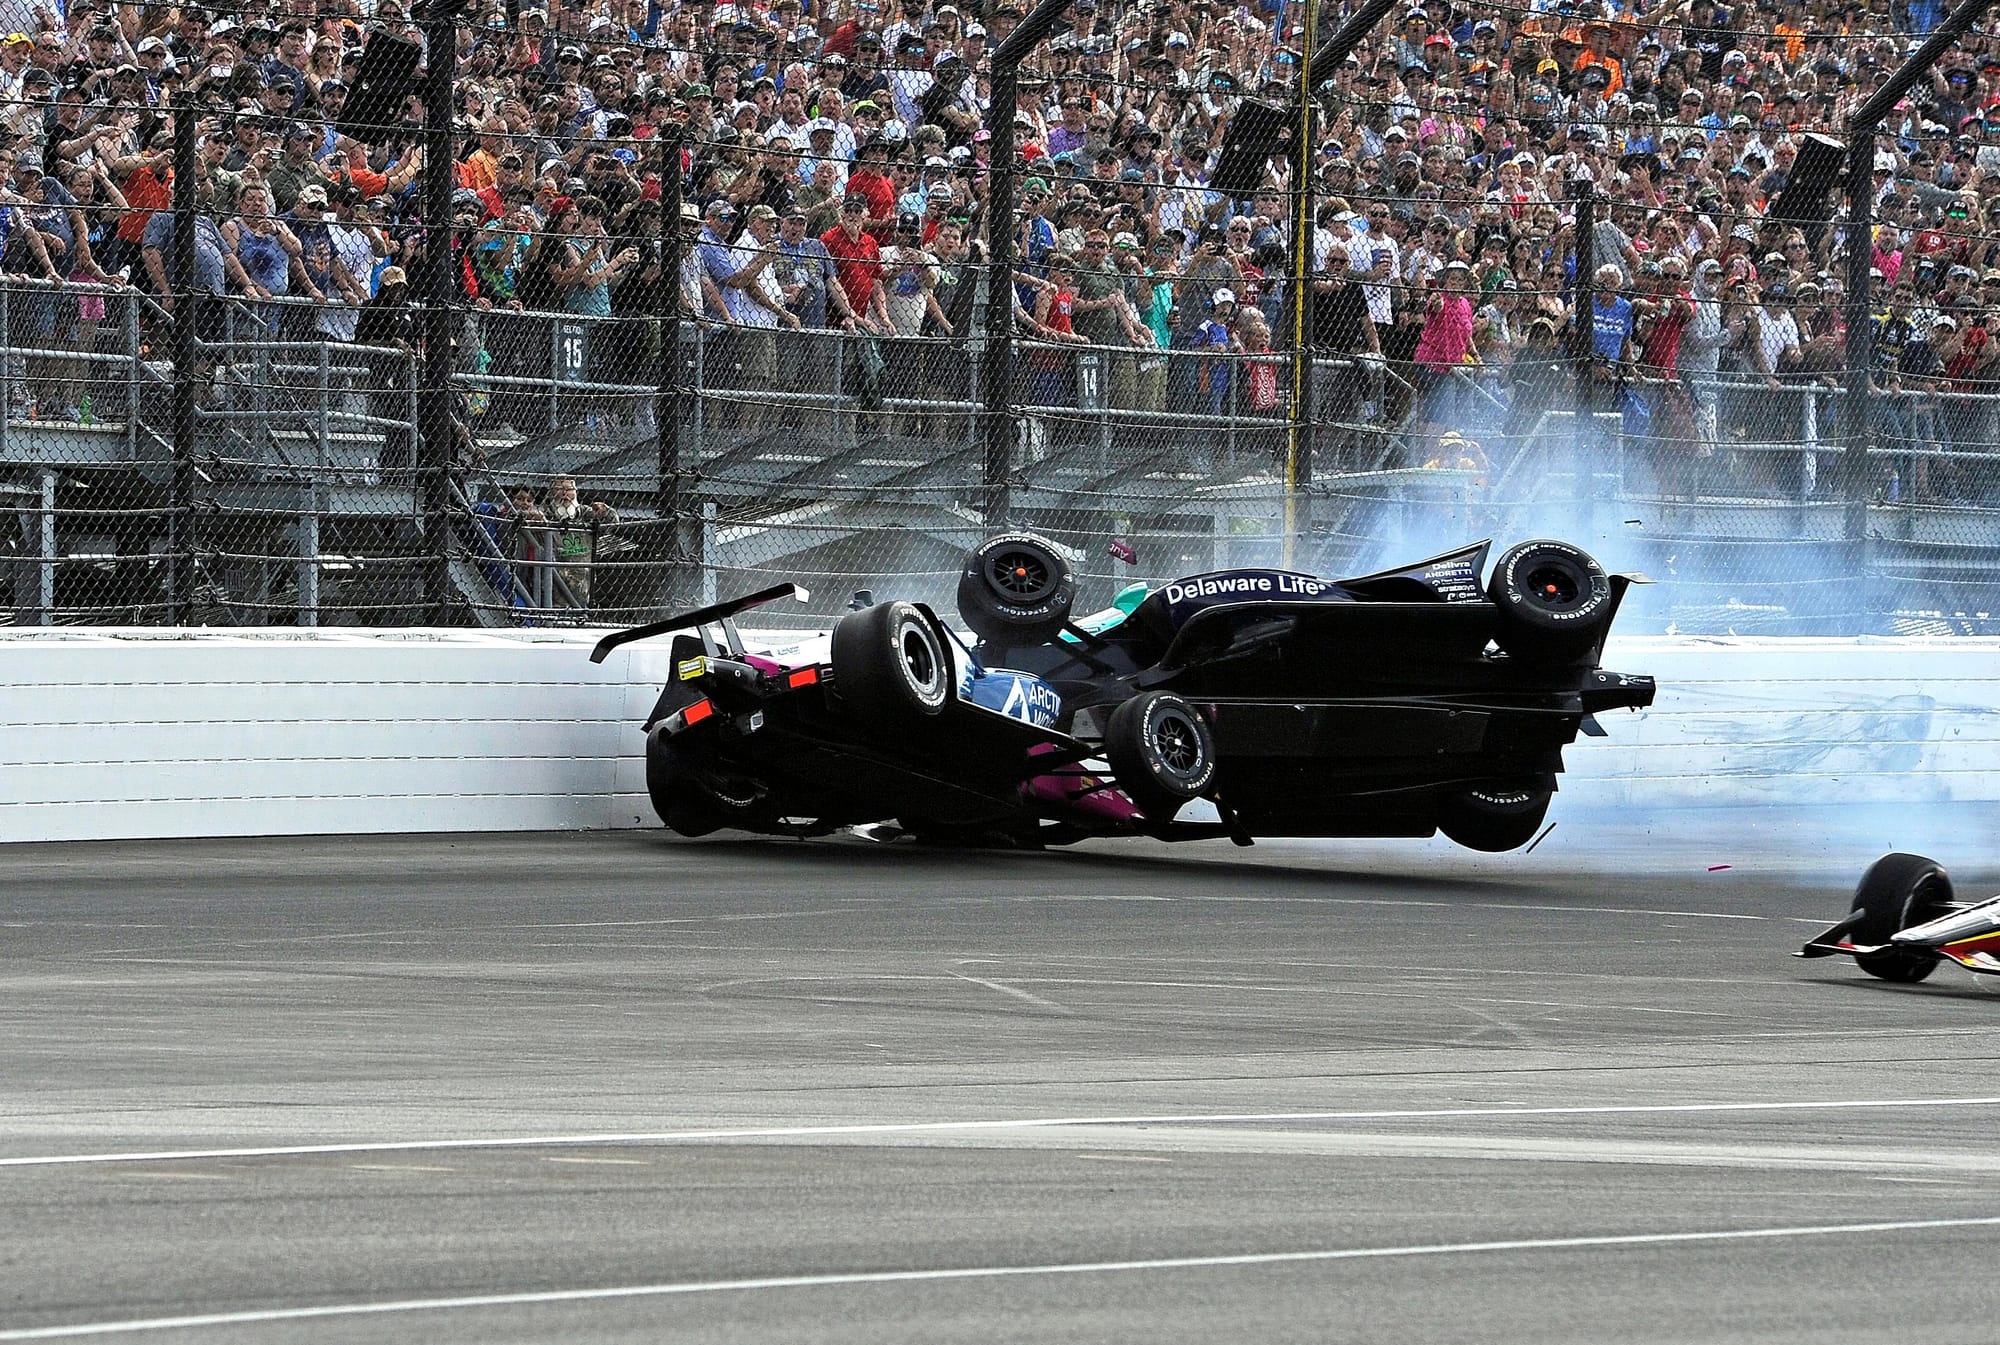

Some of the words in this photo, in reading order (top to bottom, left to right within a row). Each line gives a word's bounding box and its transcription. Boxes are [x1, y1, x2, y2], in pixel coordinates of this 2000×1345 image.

[564, 338, 582, 368] 15
[1082, 369, 1097, 396] 14
[1424, 568, 1473, 579] ANDRETTI
[1506, 543, 1539, 587] FIREHAWK
[1165, 577, 1271, 605] Delaware
